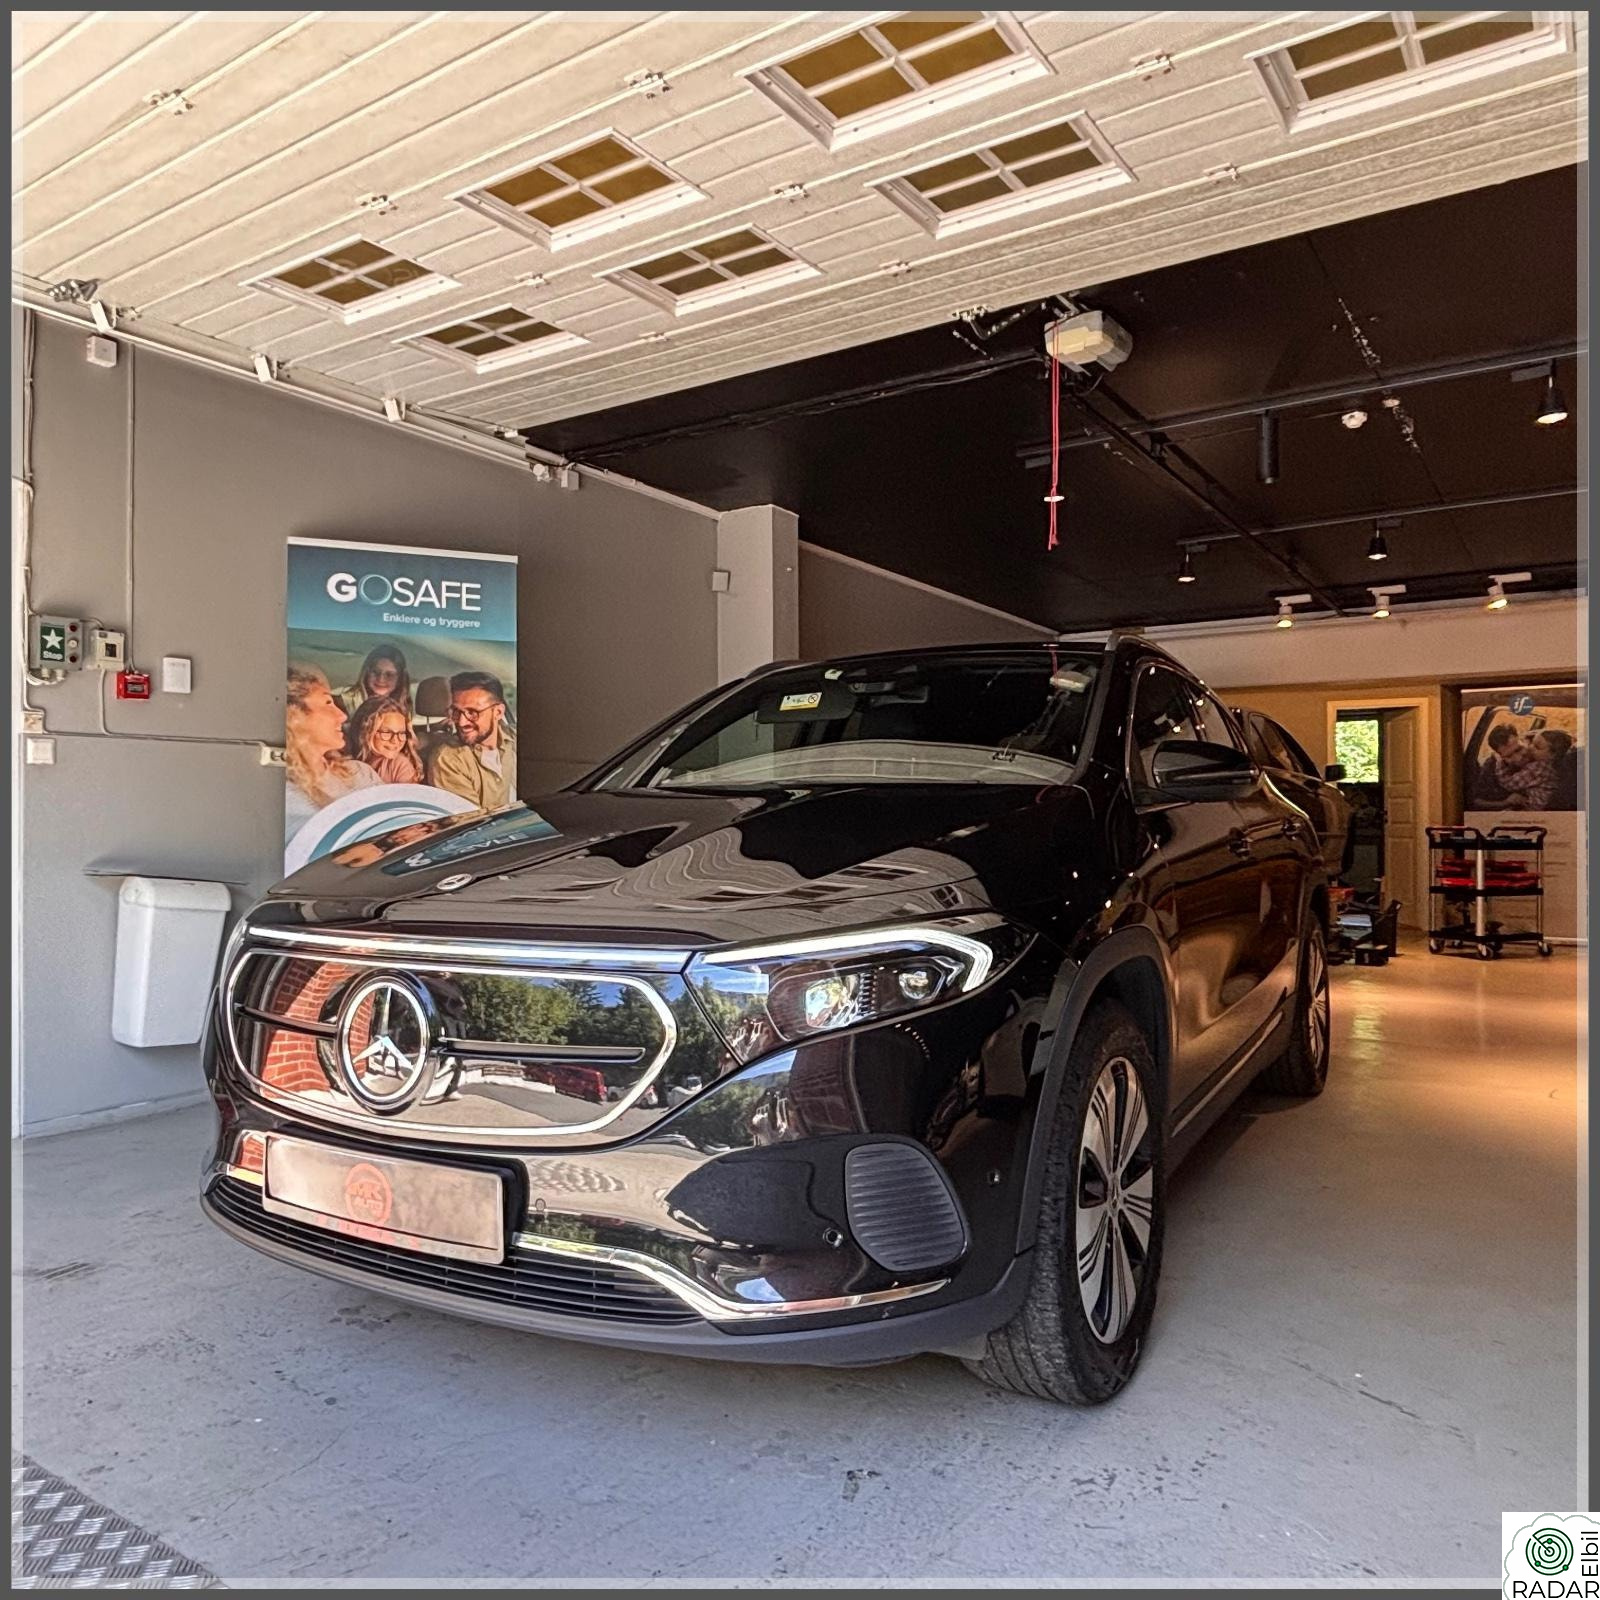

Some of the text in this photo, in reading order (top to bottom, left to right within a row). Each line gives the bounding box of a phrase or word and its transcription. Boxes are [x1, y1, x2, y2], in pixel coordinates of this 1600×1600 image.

[326, 572, 482, 612] GOSAFE
[383, 612, 481, 629] Enklere og tryggere
[43, 650, 63, 660] Stop
